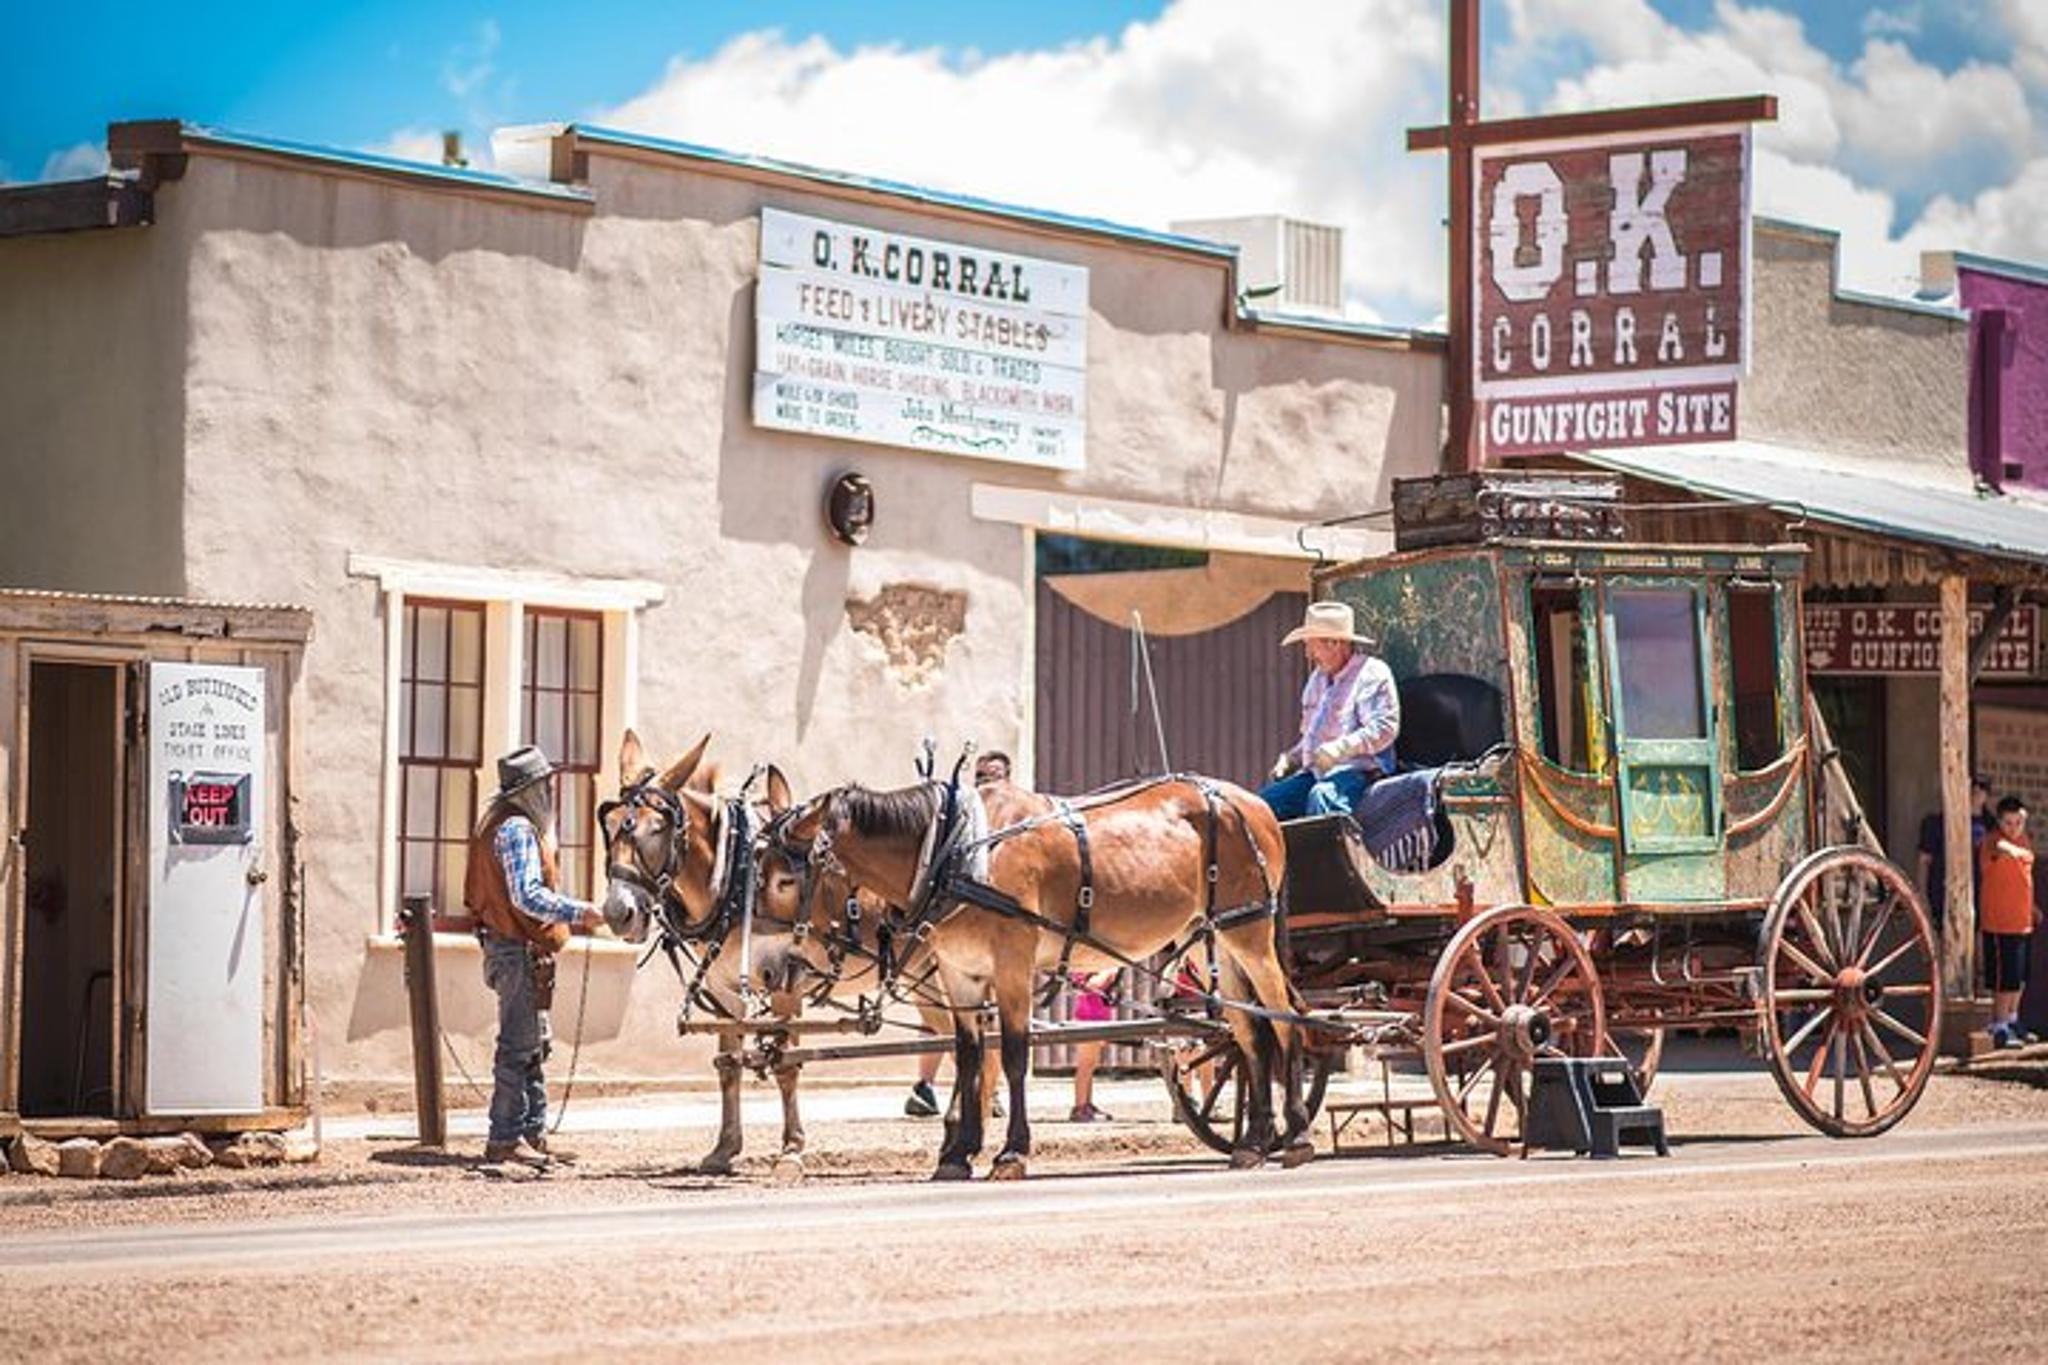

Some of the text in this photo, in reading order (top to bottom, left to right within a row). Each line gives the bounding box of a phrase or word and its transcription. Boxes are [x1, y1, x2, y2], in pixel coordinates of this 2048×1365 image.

[1490, 150, 1722, 302] O.K.
[800, 284, 853, 320] FEED
[878, 295, 949, 335] LIVERY
[958, 310, 1049, 352] STABLES
[1492, 302, 1726, 373] CORRAL
[1491, 391, 1731, 446] GUNFIGHT SITE
[1851, 610, 1905, 637] O.K.
[1982, 641, 2029, 669] ITE
[186, 783, 235, 805] KEEP
[190, 806, 229, 827] OUT
